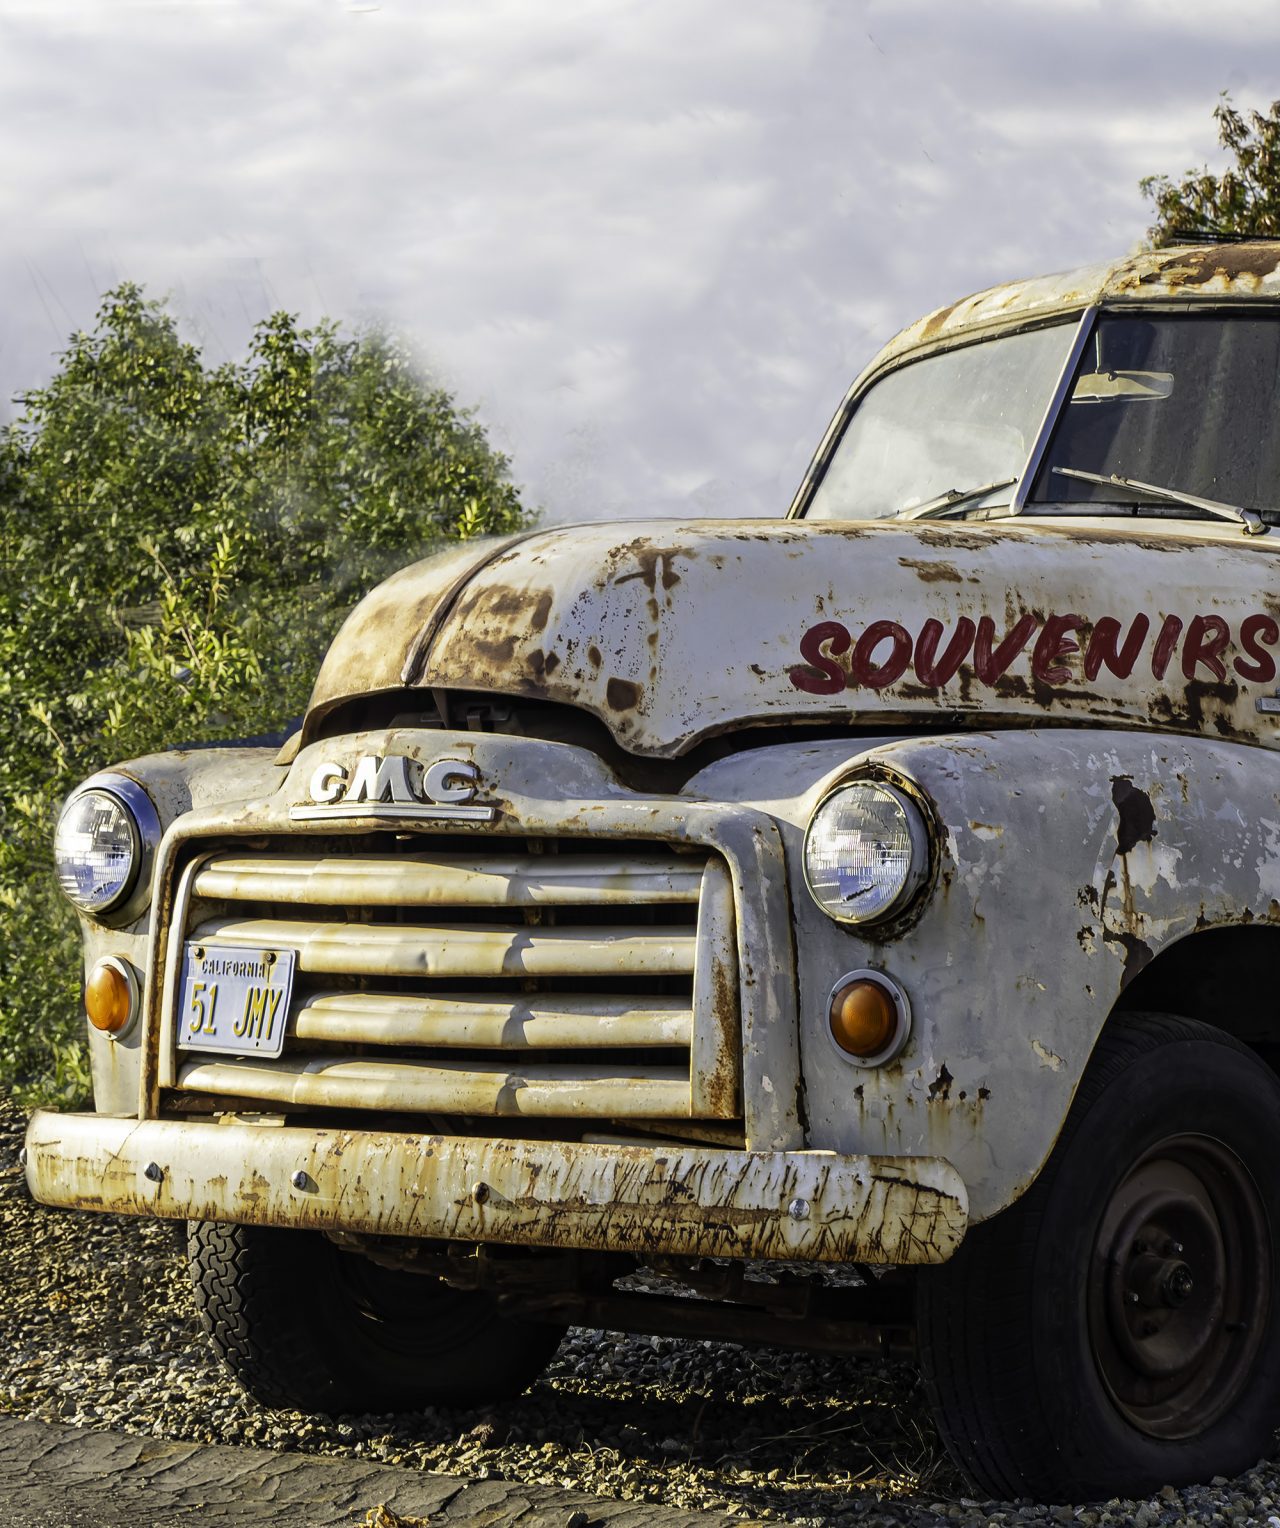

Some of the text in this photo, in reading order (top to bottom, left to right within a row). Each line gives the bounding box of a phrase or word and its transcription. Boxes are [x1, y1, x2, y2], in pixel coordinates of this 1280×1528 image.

[789, 612, 1280, 695] SOUVENIRS
[309, 755, 479, 804] GMC
[201, 959, 266, 979] CALIFORNIA
[189, 980, 283, 1041] 51 JMY
